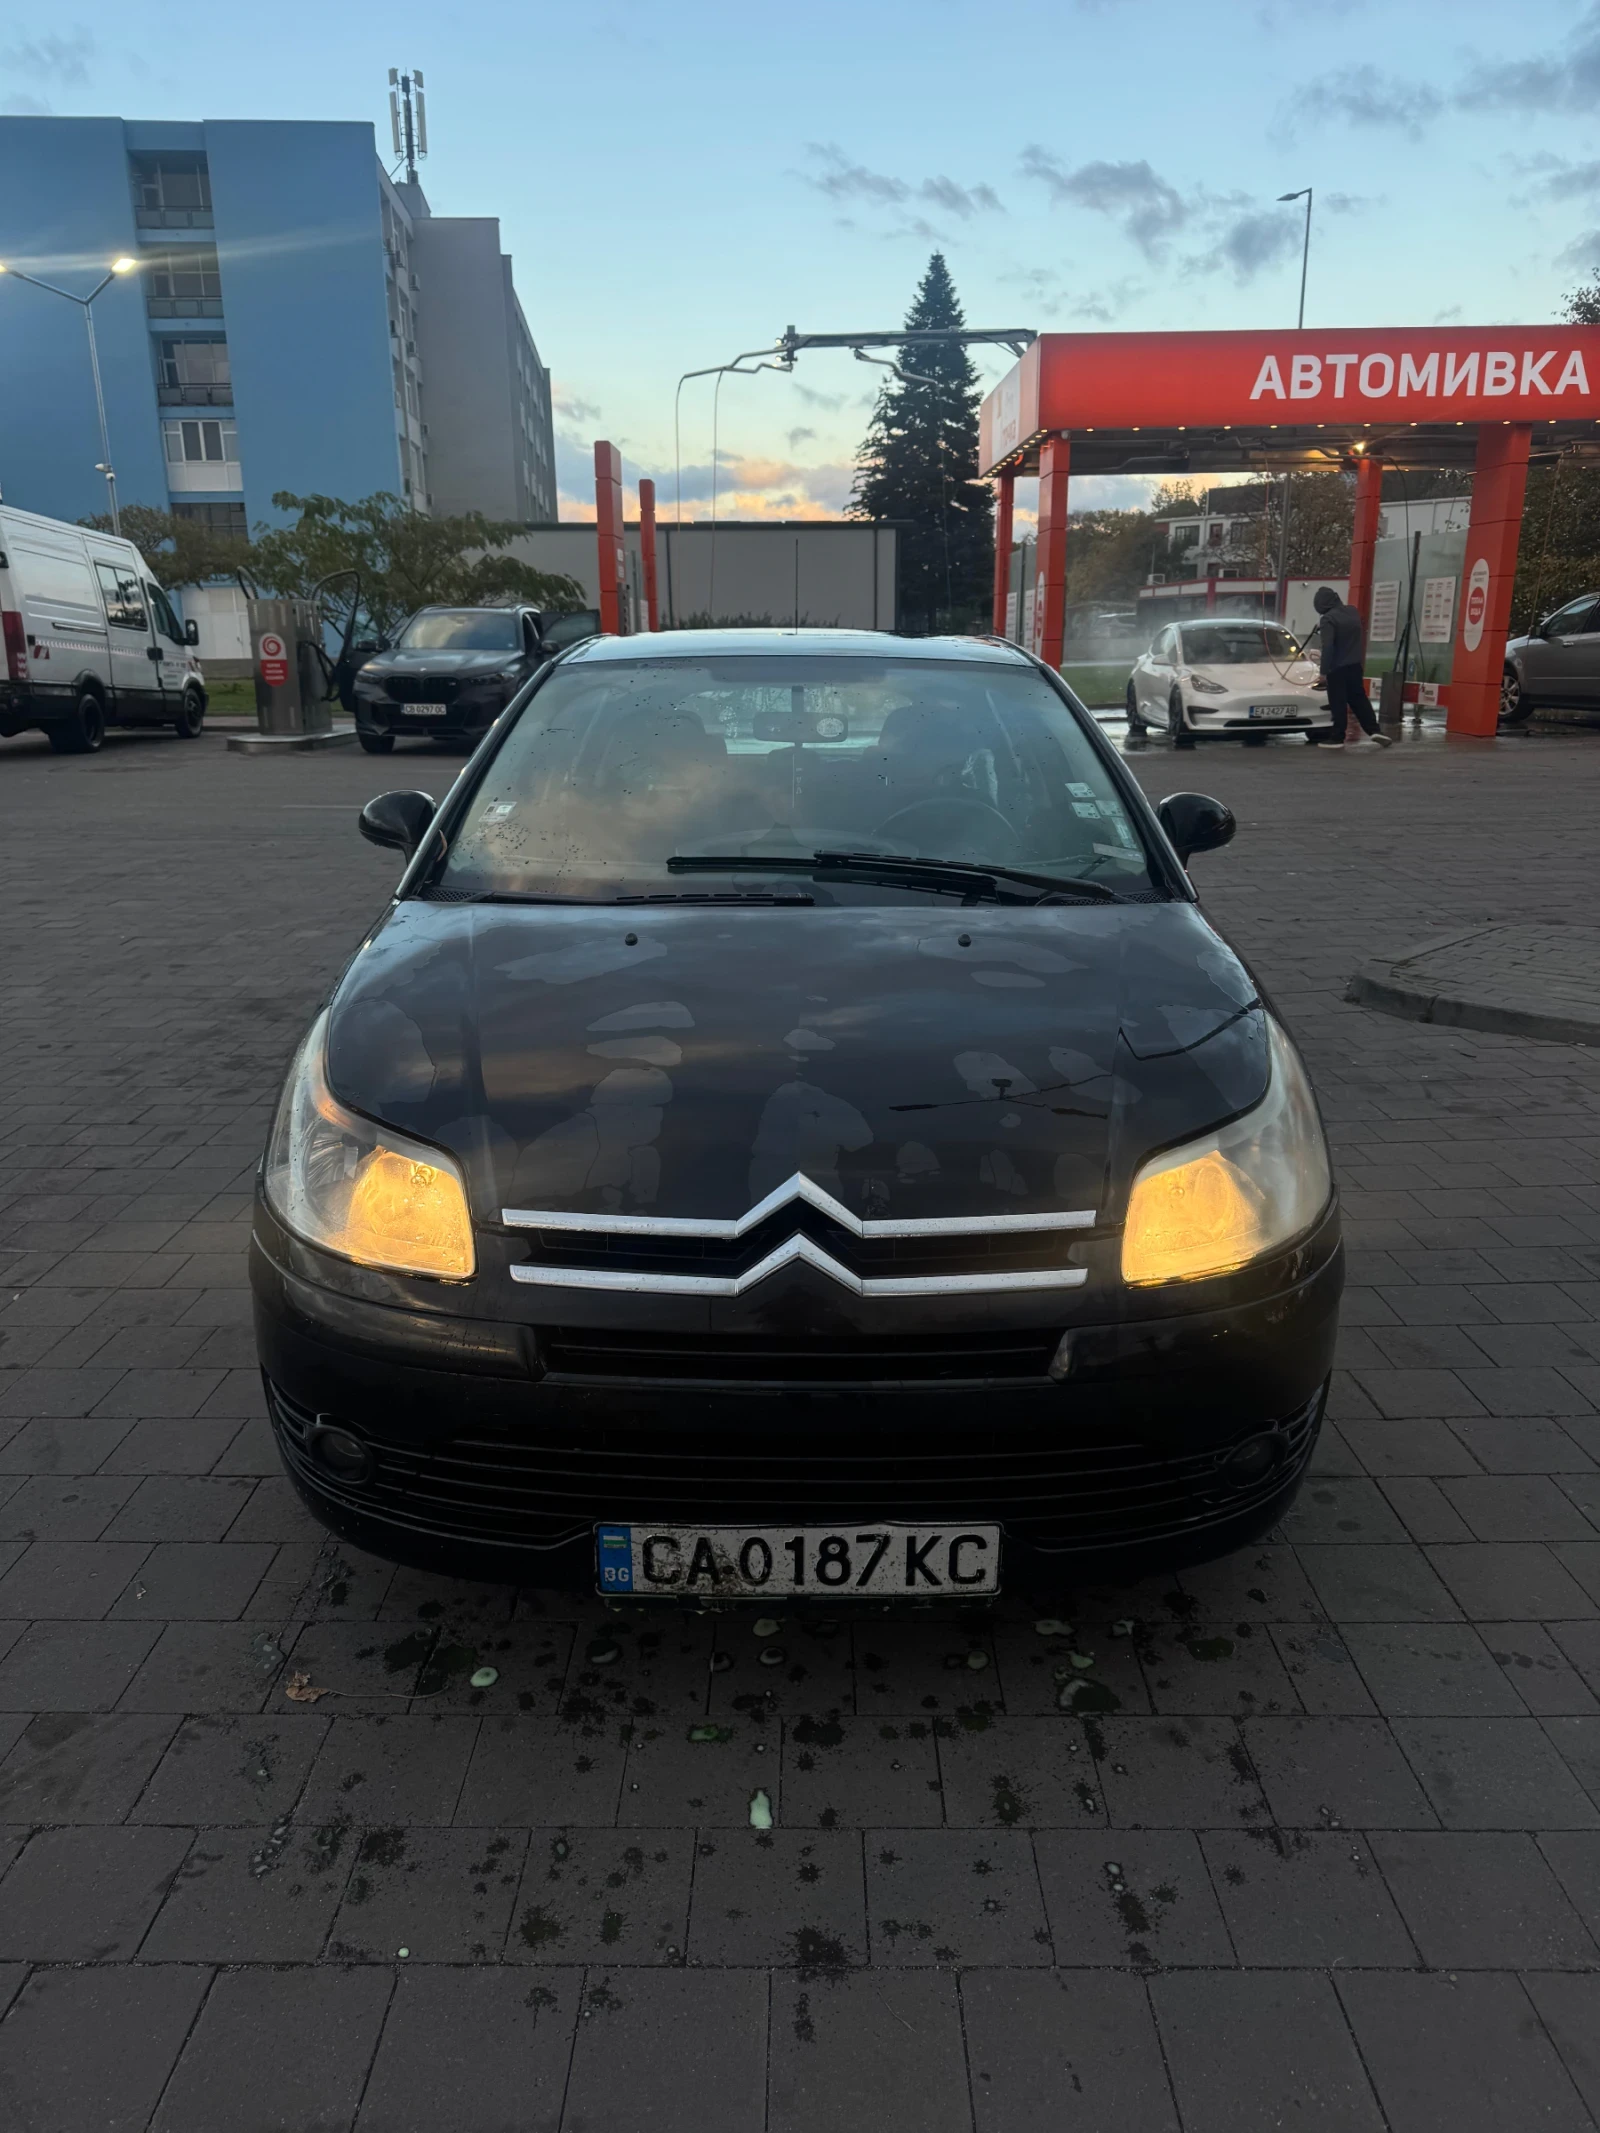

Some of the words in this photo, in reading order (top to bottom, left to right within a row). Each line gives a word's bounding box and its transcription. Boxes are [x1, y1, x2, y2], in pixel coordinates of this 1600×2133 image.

[1249, 350, 1591, 400] АВТОМИВКА
[604, 1567, 630, 1582] BG
[642, 1533, 720, 1587] CA
[738, 1535, 892, 1588] 0187
[904, 1534, 989, 1587] KC
